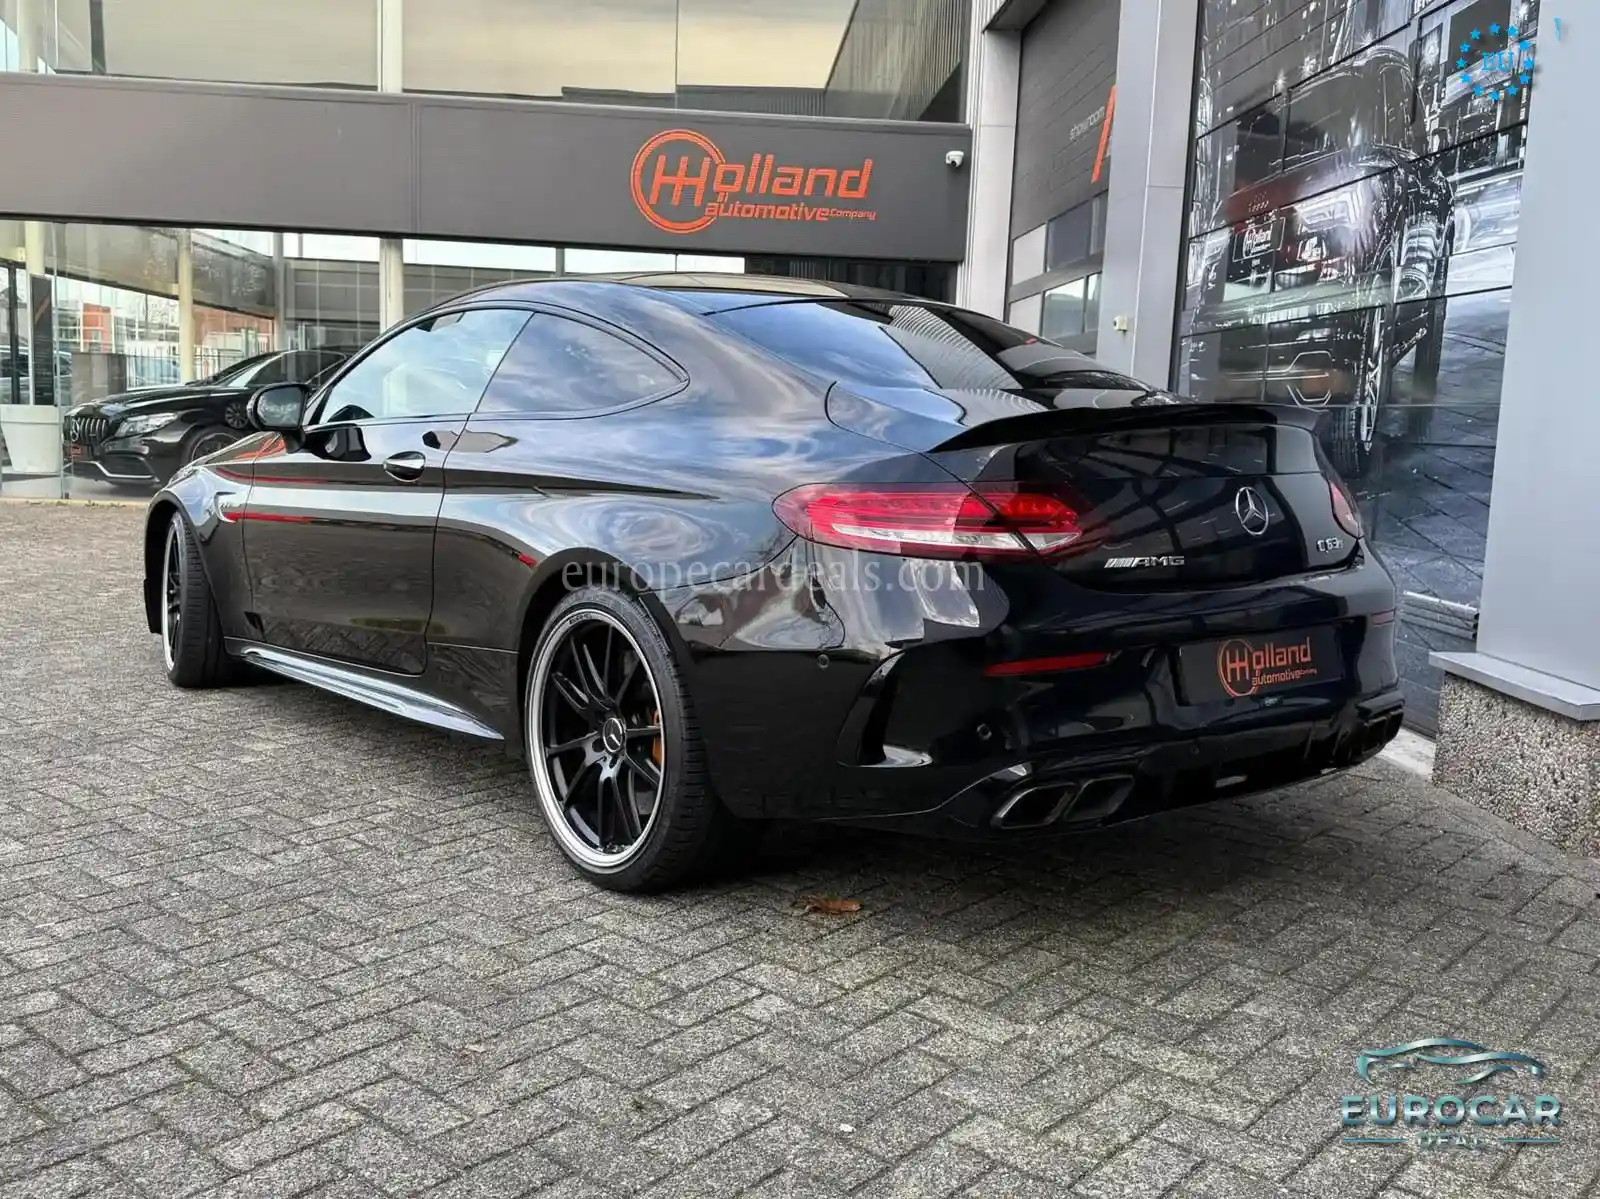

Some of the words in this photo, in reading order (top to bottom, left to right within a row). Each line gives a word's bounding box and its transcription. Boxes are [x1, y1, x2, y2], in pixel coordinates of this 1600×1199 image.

[650, 153, 873, 206] Holland
[704, 200, 829, 221] automotive
[828, 207, 877, 221] Company
[1226, 636, 1311, 682] Holland
[1252, 668, 1301, 686] automotive
